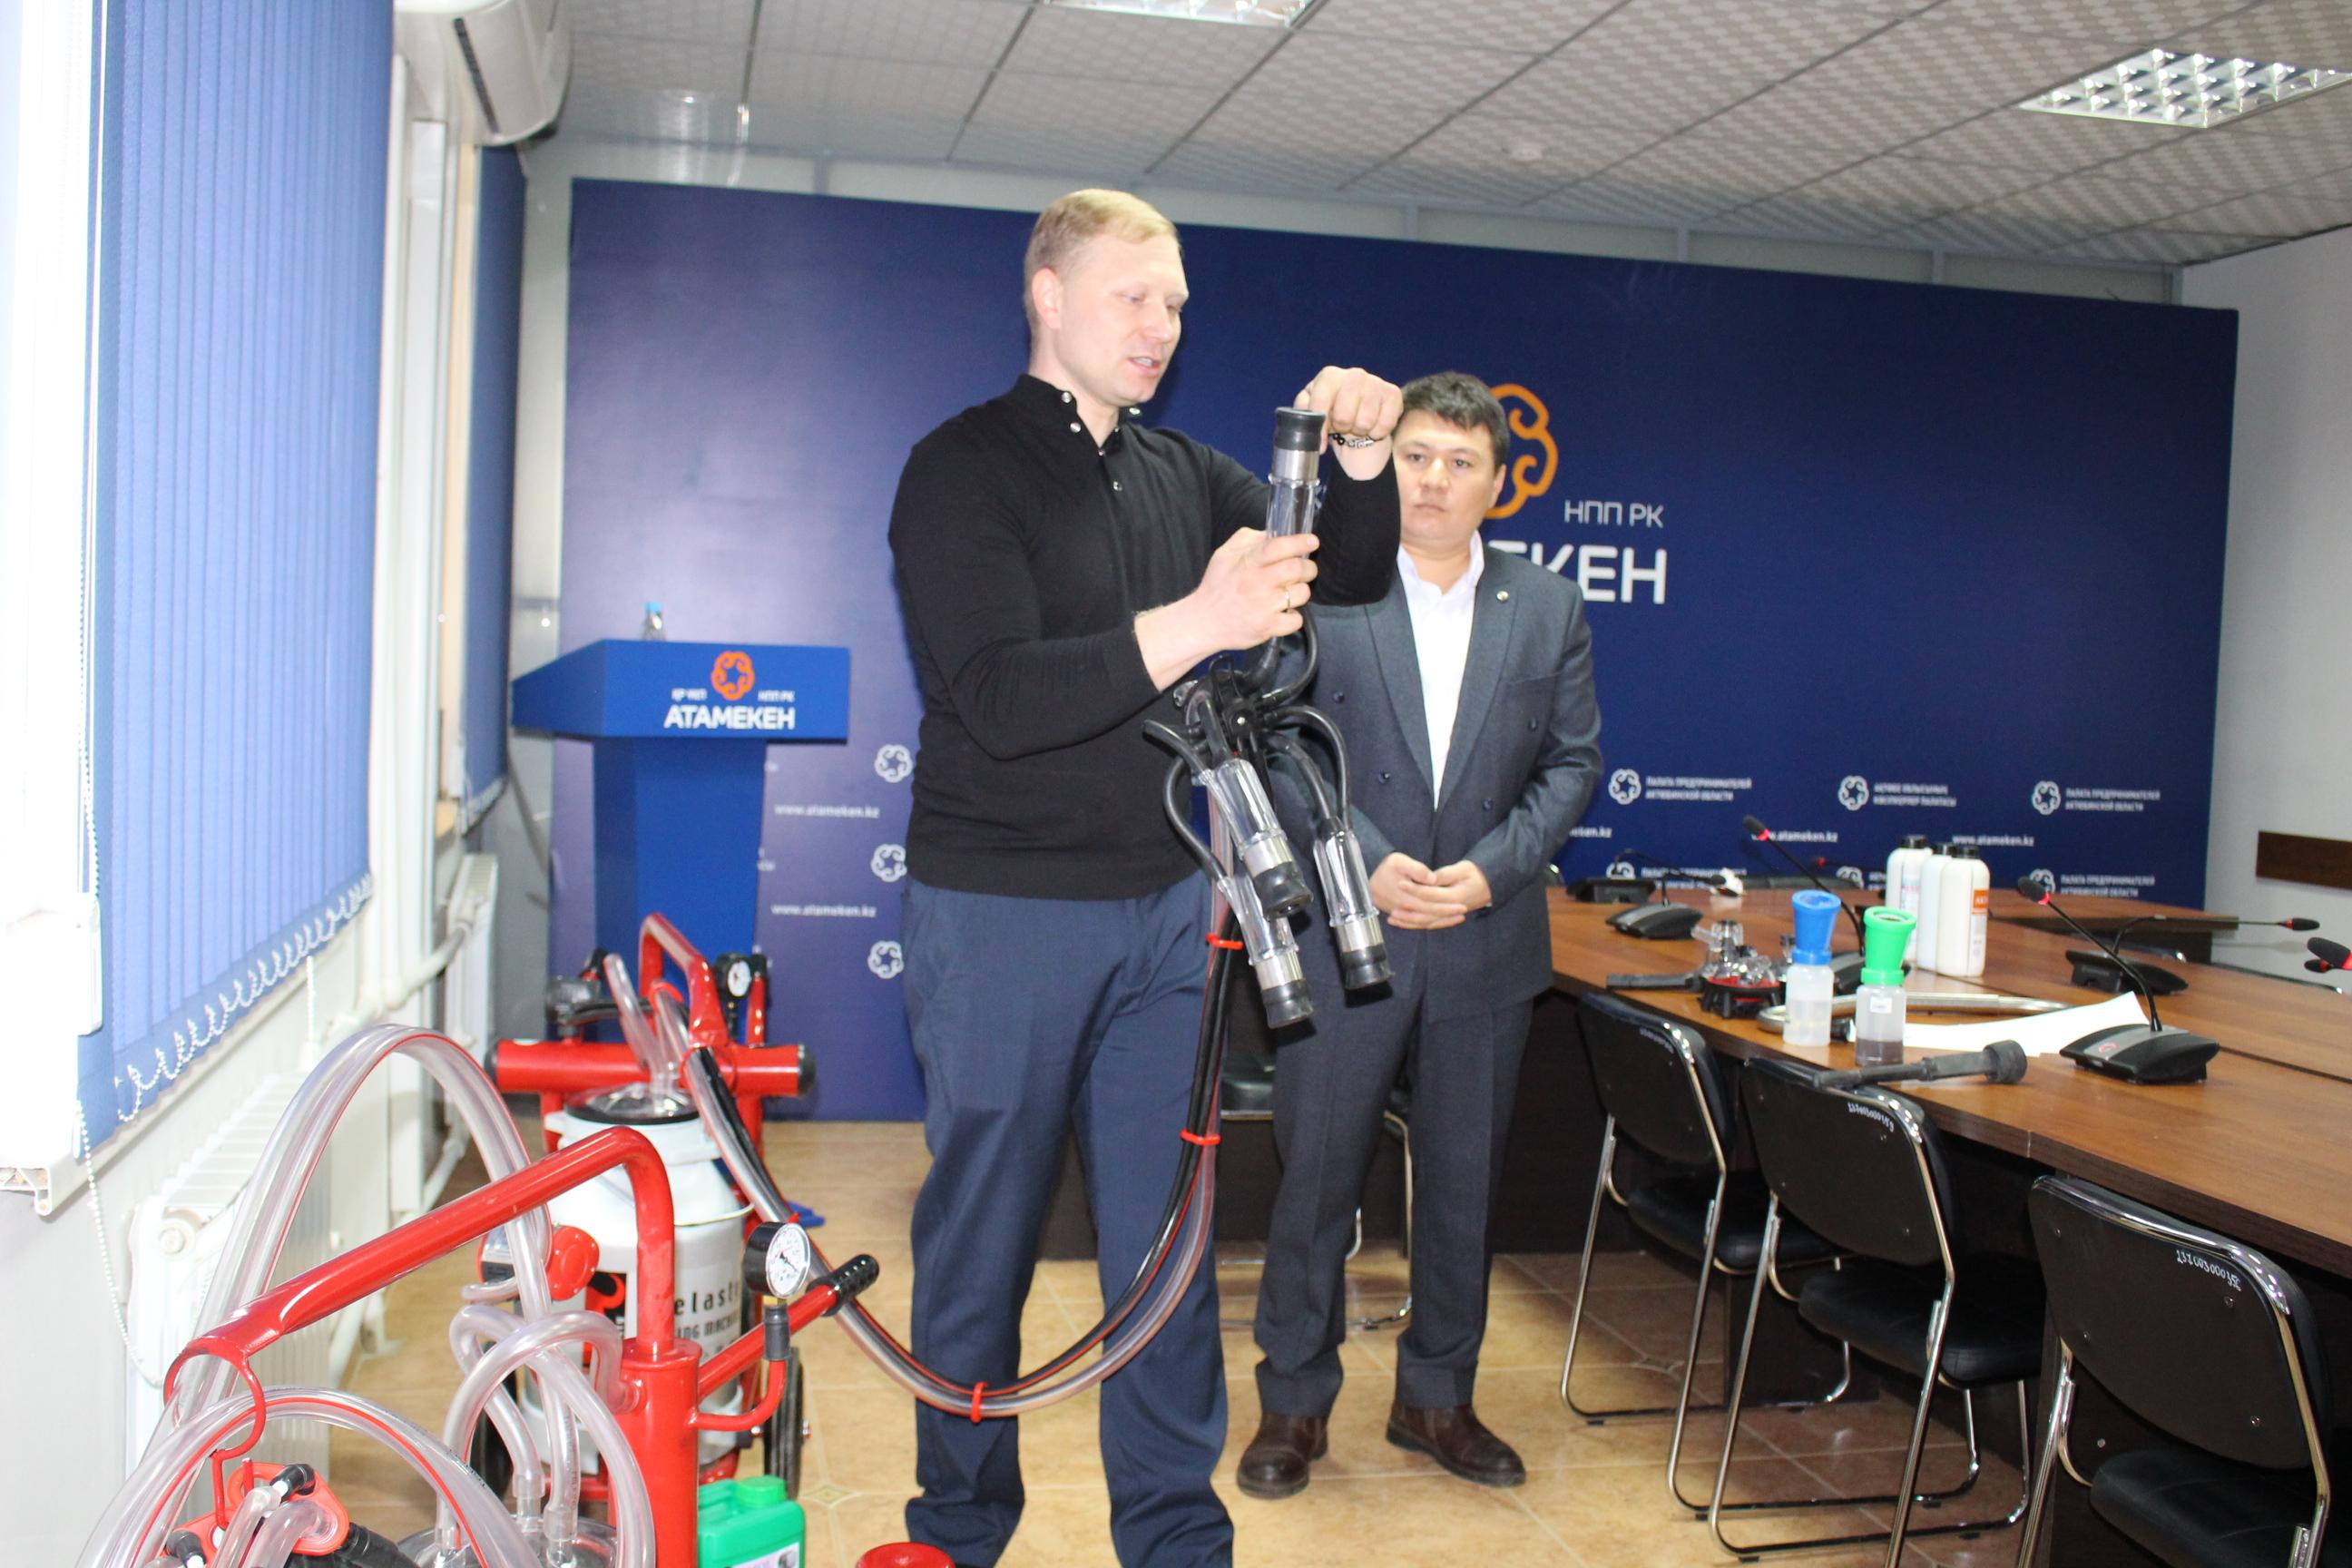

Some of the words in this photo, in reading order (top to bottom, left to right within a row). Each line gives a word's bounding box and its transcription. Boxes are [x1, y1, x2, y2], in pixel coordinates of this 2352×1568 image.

[1564, 500, 1622, 525] НПП
[1630, 503, 1664, 528] РК
[663, 704, 796, 730] АТАМЕКЕН
[674, 1279, 740, 1316] elast
